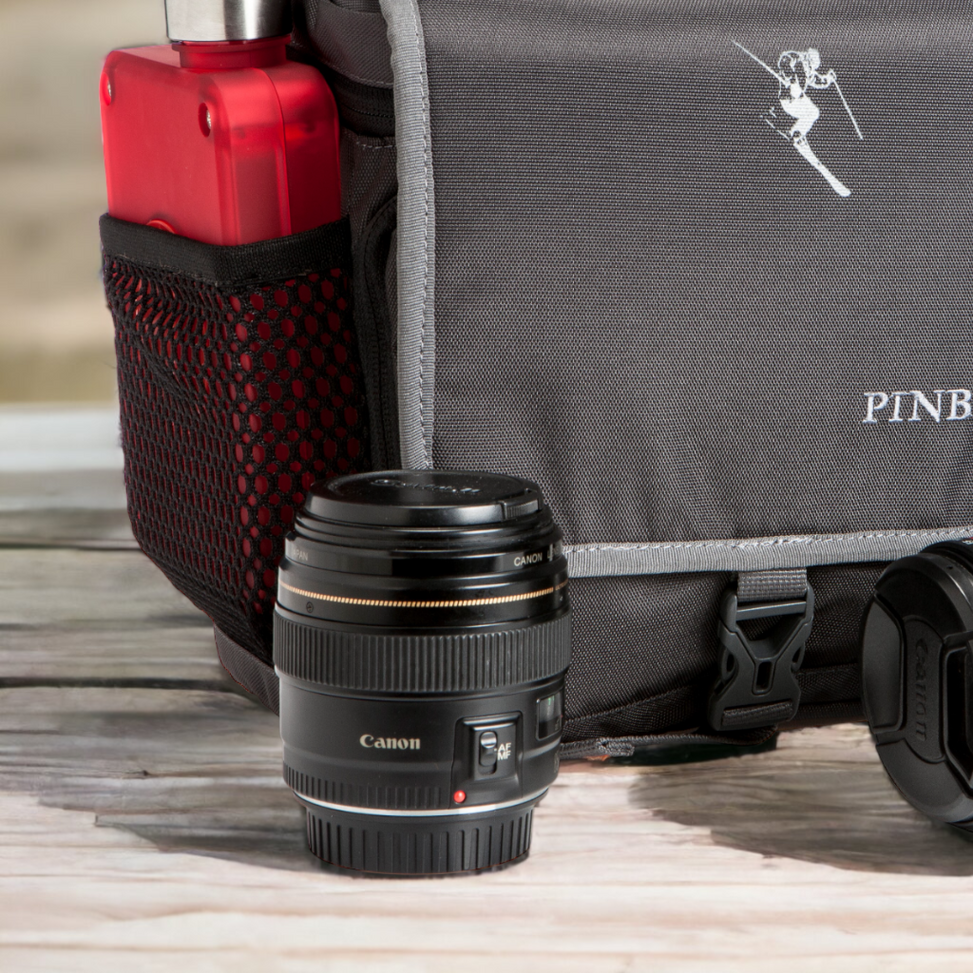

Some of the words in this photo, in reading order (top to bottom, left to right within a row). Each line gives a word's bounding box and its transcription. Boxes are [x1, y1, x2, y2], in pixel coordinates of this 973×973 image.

[513, 552, 543, 567] CANON
[359, 733, 421, 750] Canon
[497, 742, 512, 752] AF
[497, 750, 511, 761] MF
